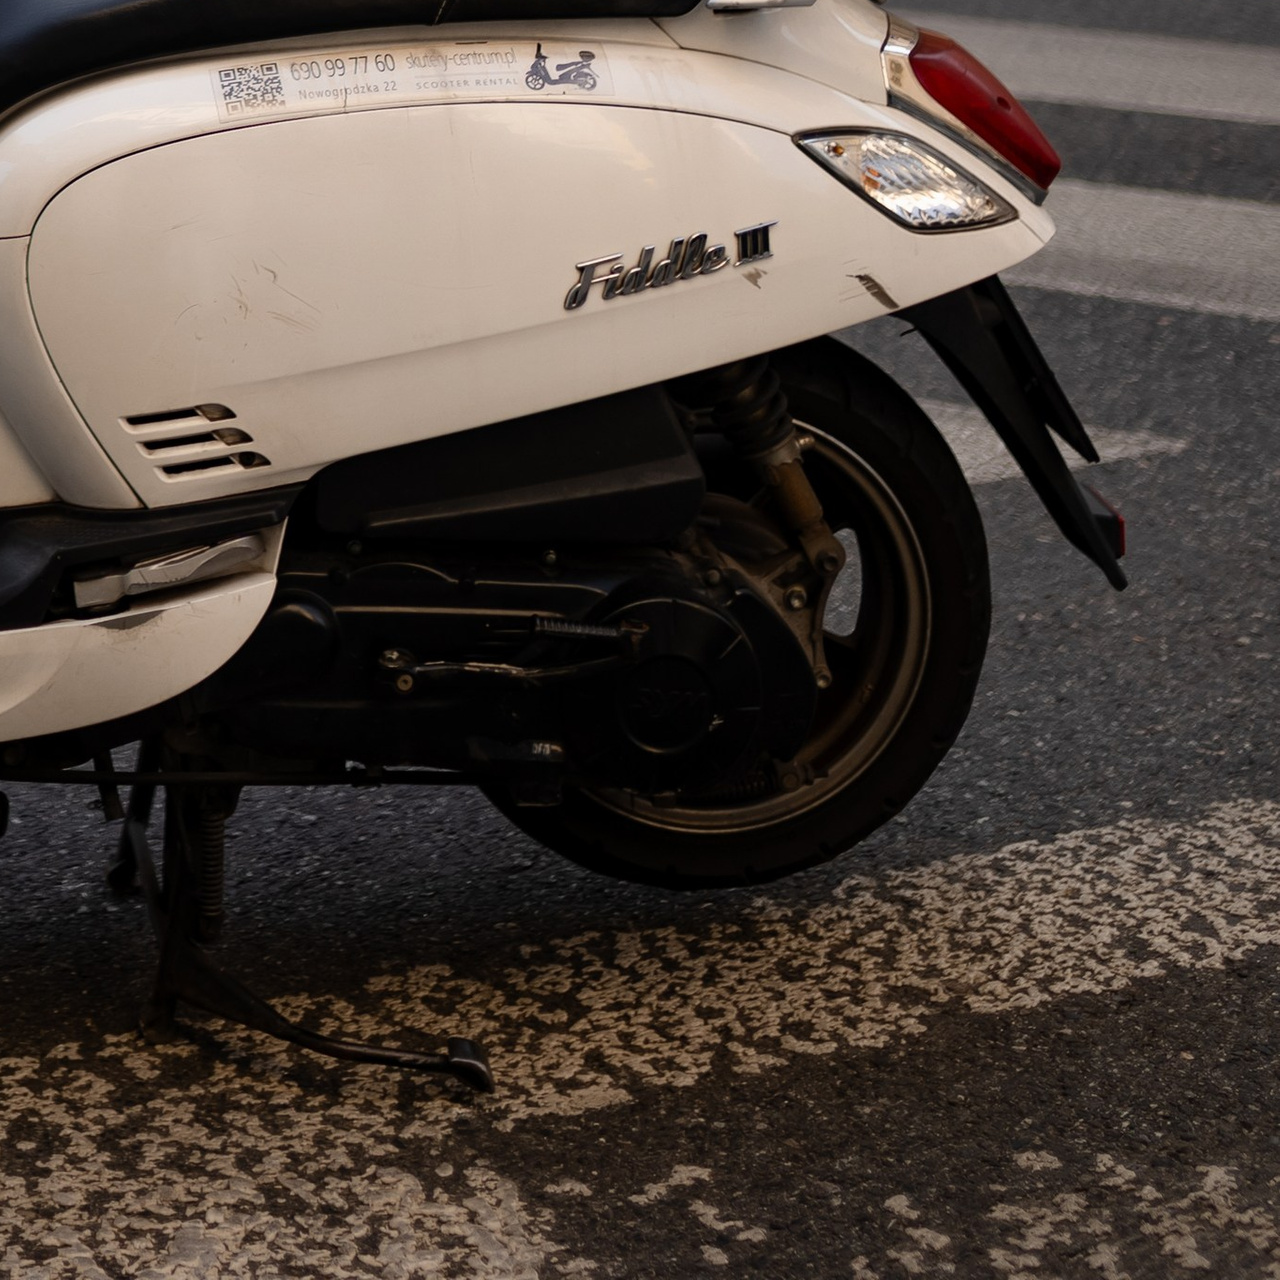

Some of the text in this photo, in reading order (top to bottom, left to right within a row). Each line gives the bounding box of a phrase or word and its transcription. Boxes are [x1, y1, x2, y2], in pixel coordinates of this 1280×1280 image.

[290, 53, 396, 81] 690 99 77 60
[299, 80, 398, 100] Nowogrodzka 22
[416, 77, 519, 90] SCOOTER RENTAL
[563, 231, 731, 310] Fiddle
